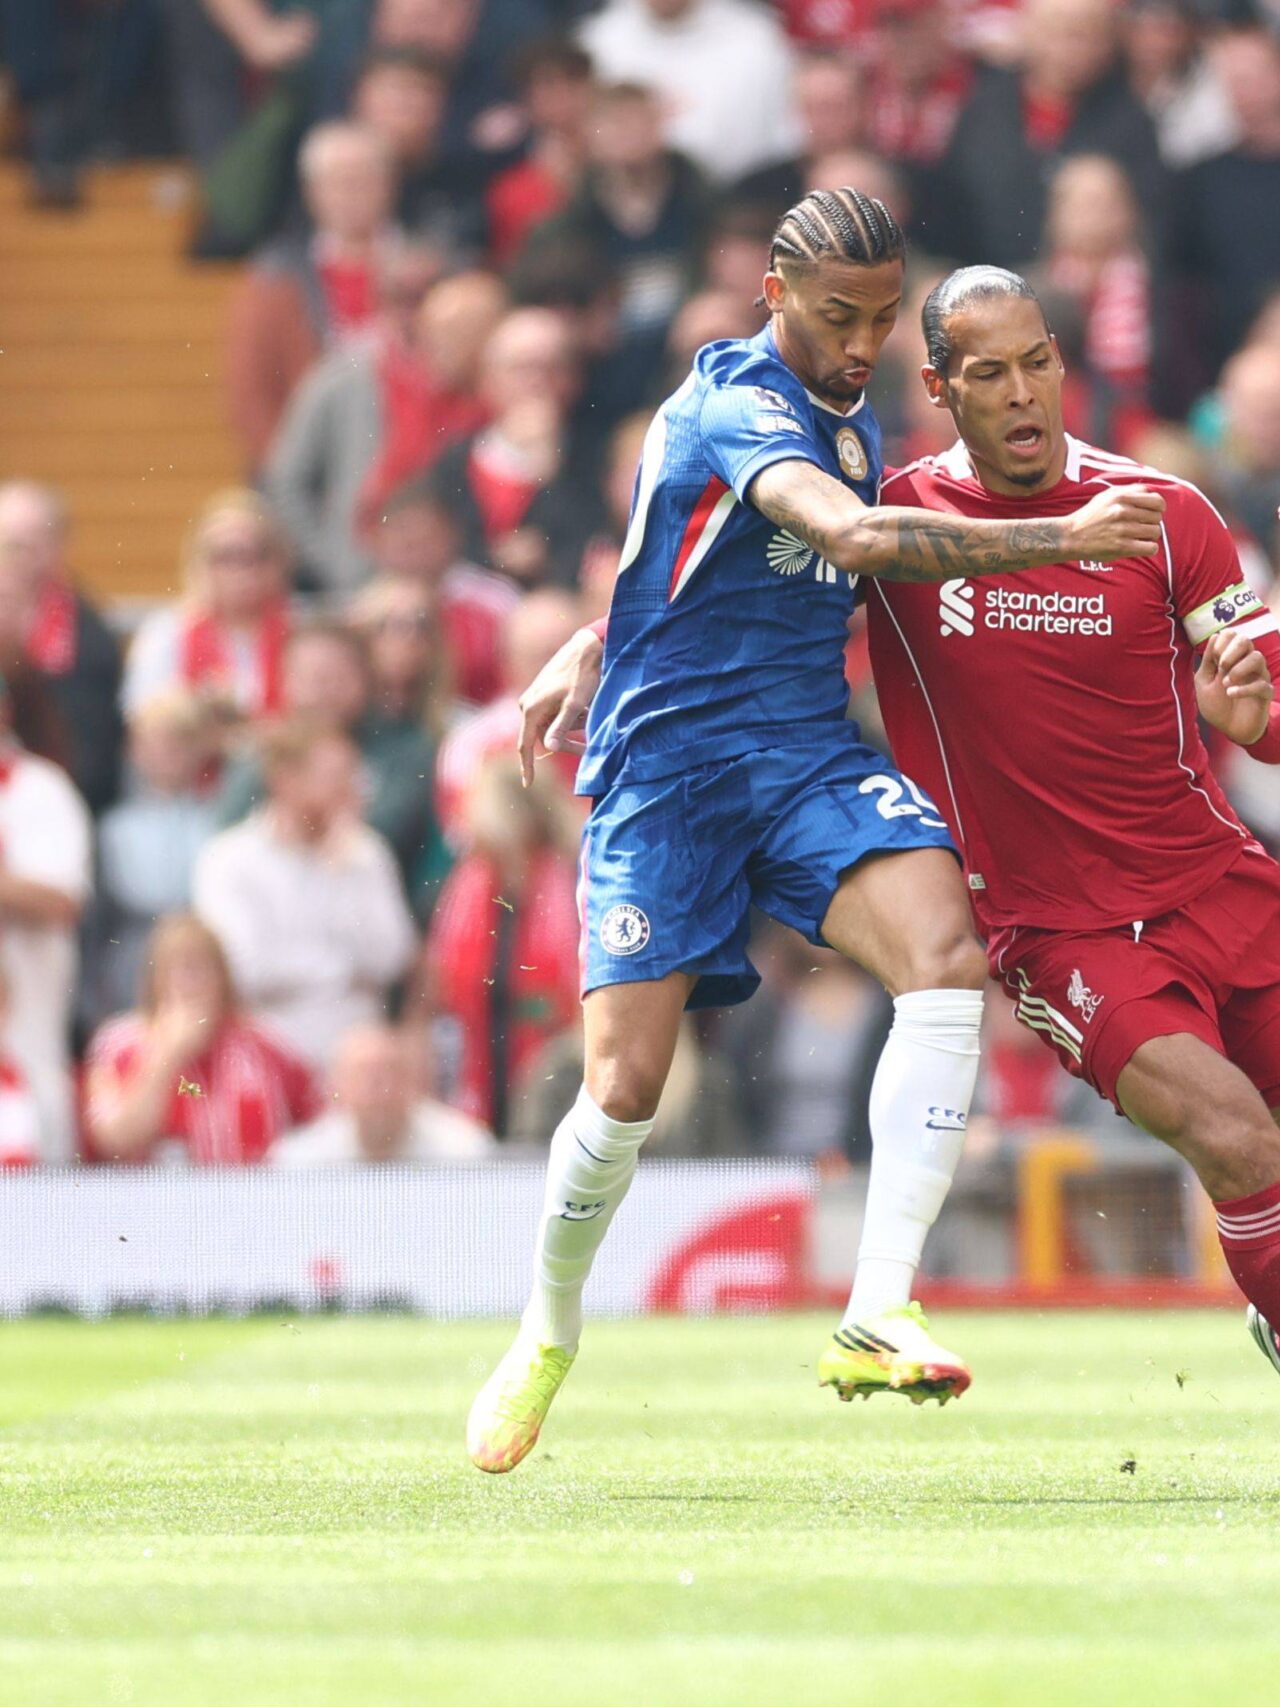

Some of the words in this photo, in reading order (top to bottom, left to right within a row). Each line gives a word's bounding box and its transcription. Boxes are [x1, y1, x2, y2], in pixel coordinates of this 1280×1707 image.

[985, 587, 1103, 614] standard
[985, 608, 1112, 636] chartered
[928, 1106, 966, 1123] CFC
